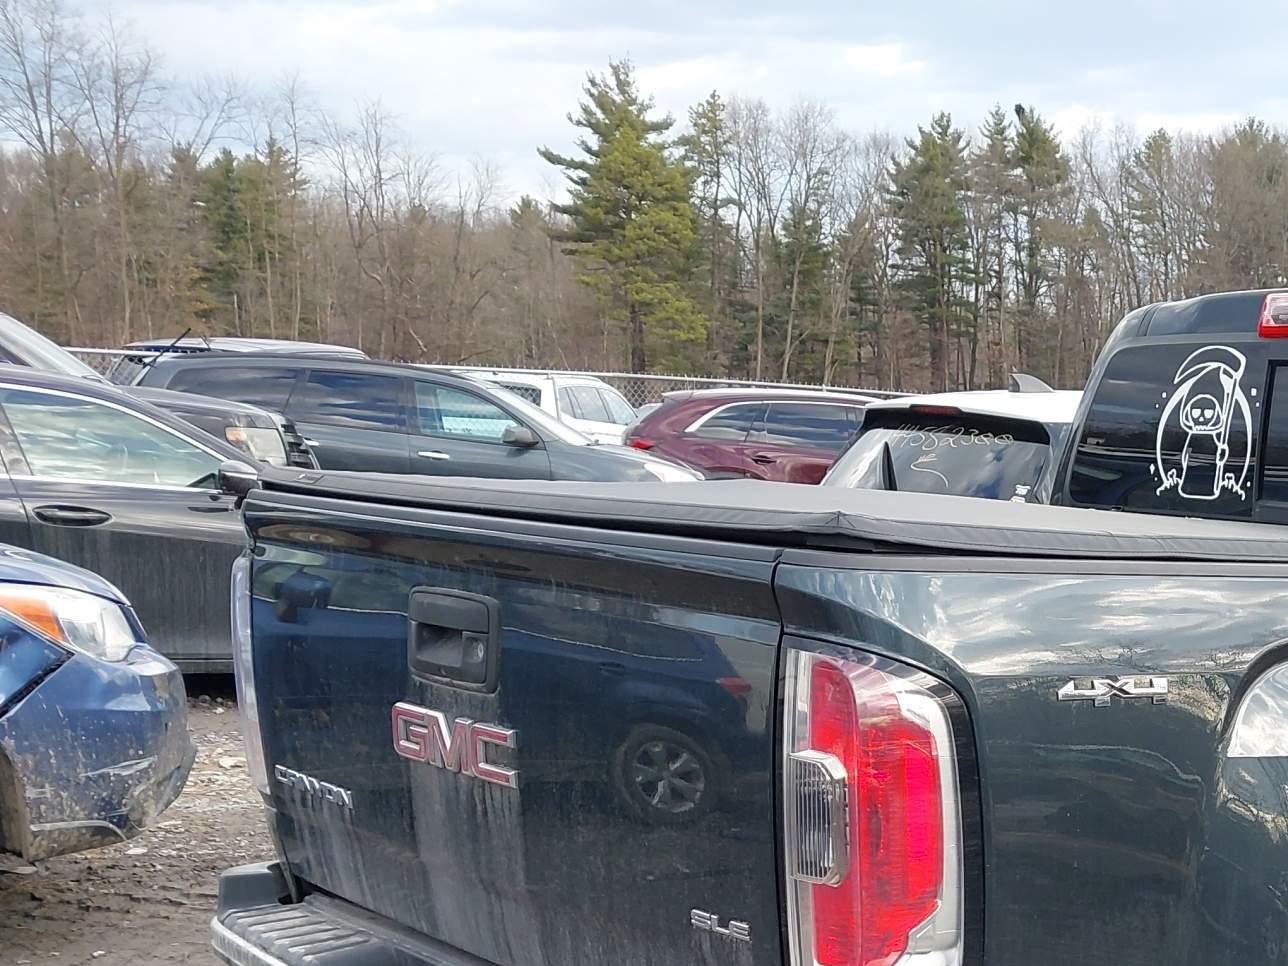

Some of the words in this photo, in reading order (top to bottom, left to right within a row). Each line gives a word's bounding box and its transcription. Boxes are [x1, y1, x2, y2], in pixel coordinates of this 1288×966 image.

[391, 701, 519, 789] GMC
[274, 764, 353, 808] CANYON
[691, 908, 750, 941] SLE
